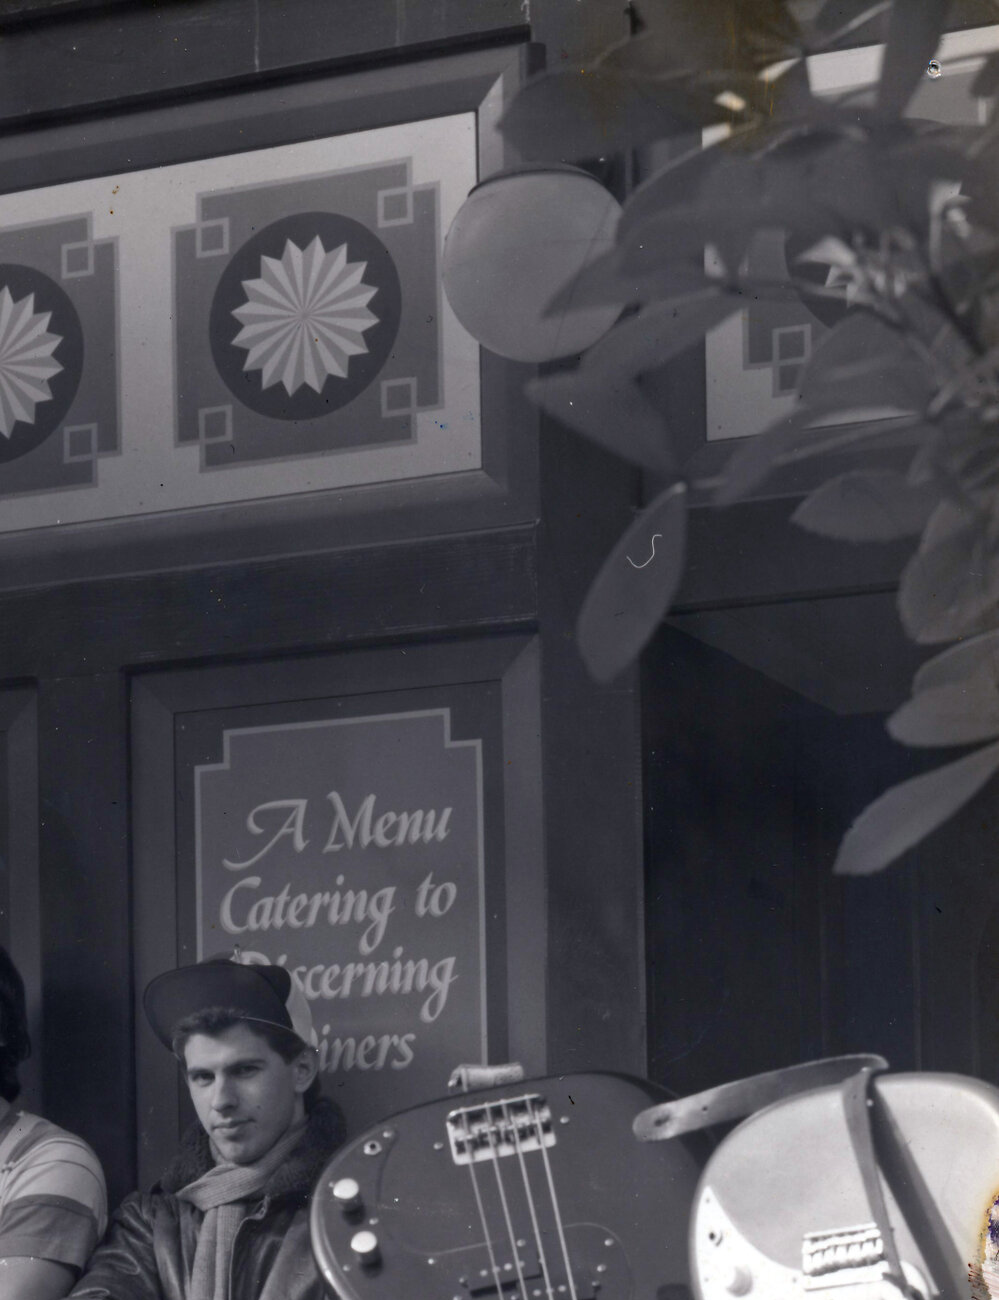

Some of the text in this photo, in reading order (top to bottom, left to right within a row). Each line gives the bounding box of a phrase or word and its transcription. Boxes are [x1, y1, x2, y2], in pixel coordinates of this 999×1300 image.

[222, 790, 453, 871] A Menu
[219, 871, 458, 955] Catering to
[230, 946, 459, 1023] scerning
[311, 1023, 416, 1074] iners
